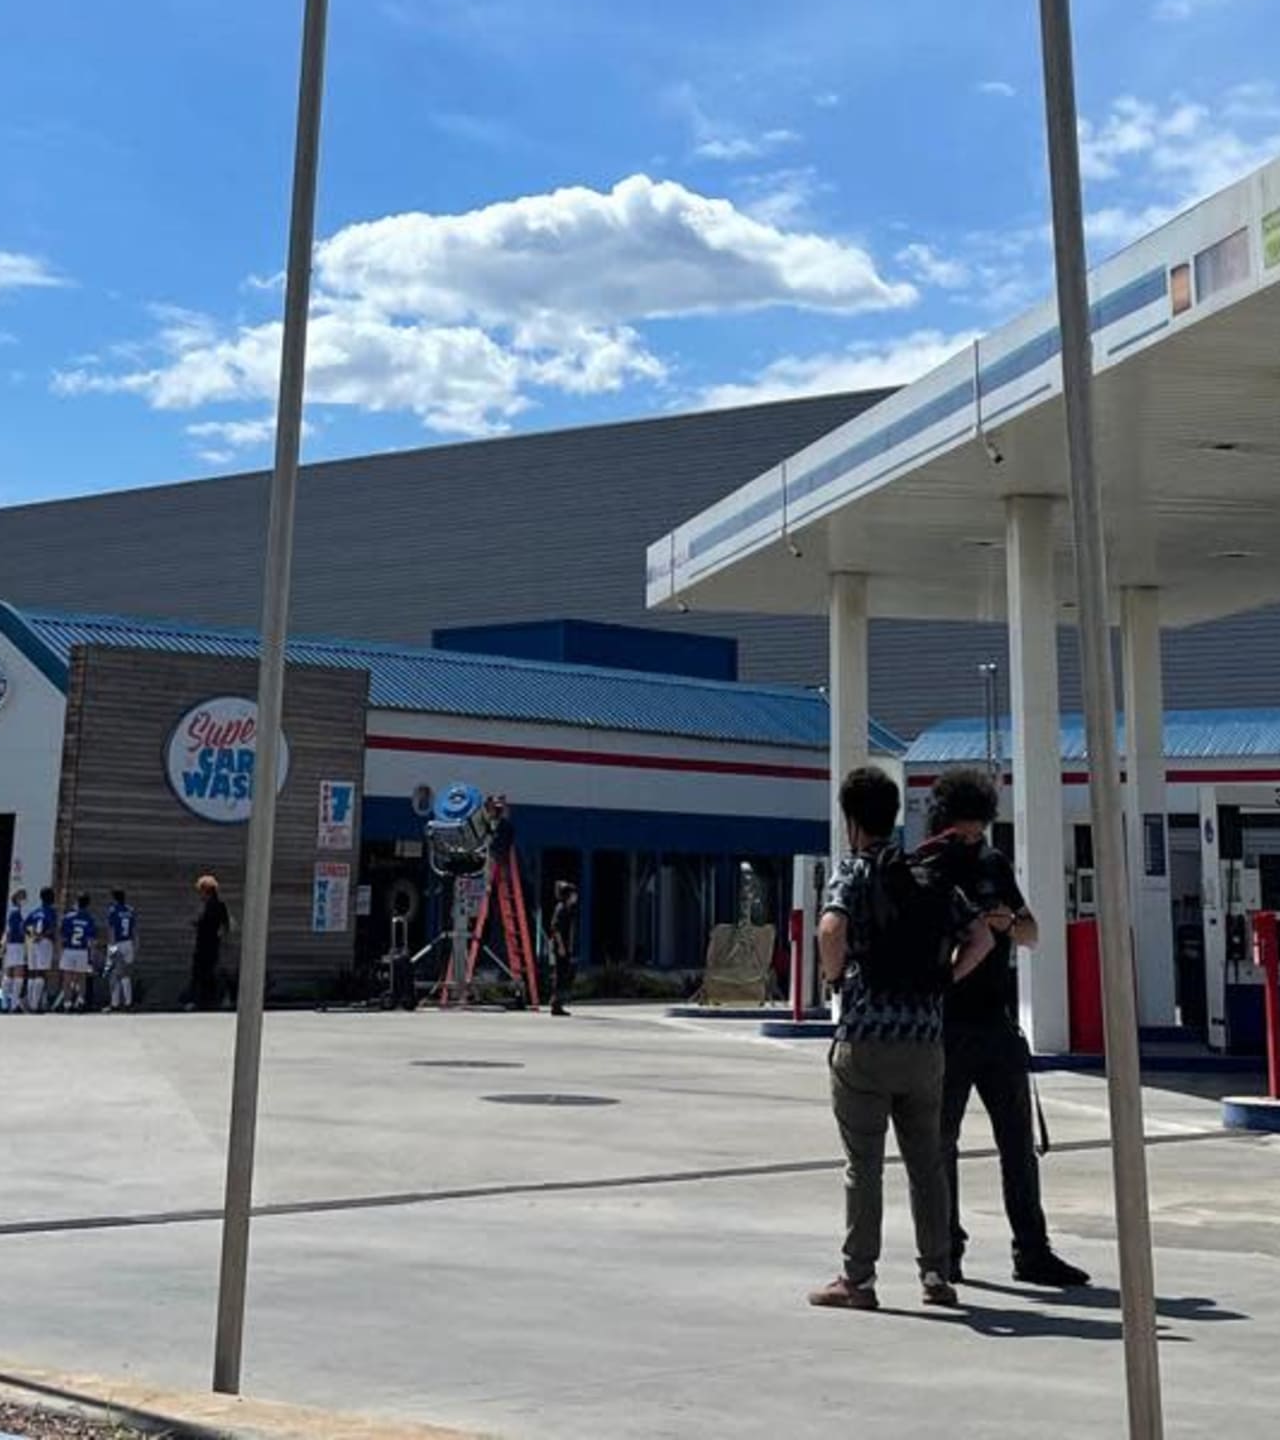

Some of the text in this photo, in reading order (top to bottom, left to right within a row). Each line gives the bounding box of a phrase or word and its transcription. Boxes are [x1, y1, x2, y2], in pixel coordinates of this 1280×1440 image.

[187, 711, 256, 752] Supe
[182, 771, 256, 800] WAS
[71, 926, 84, 946] 2
